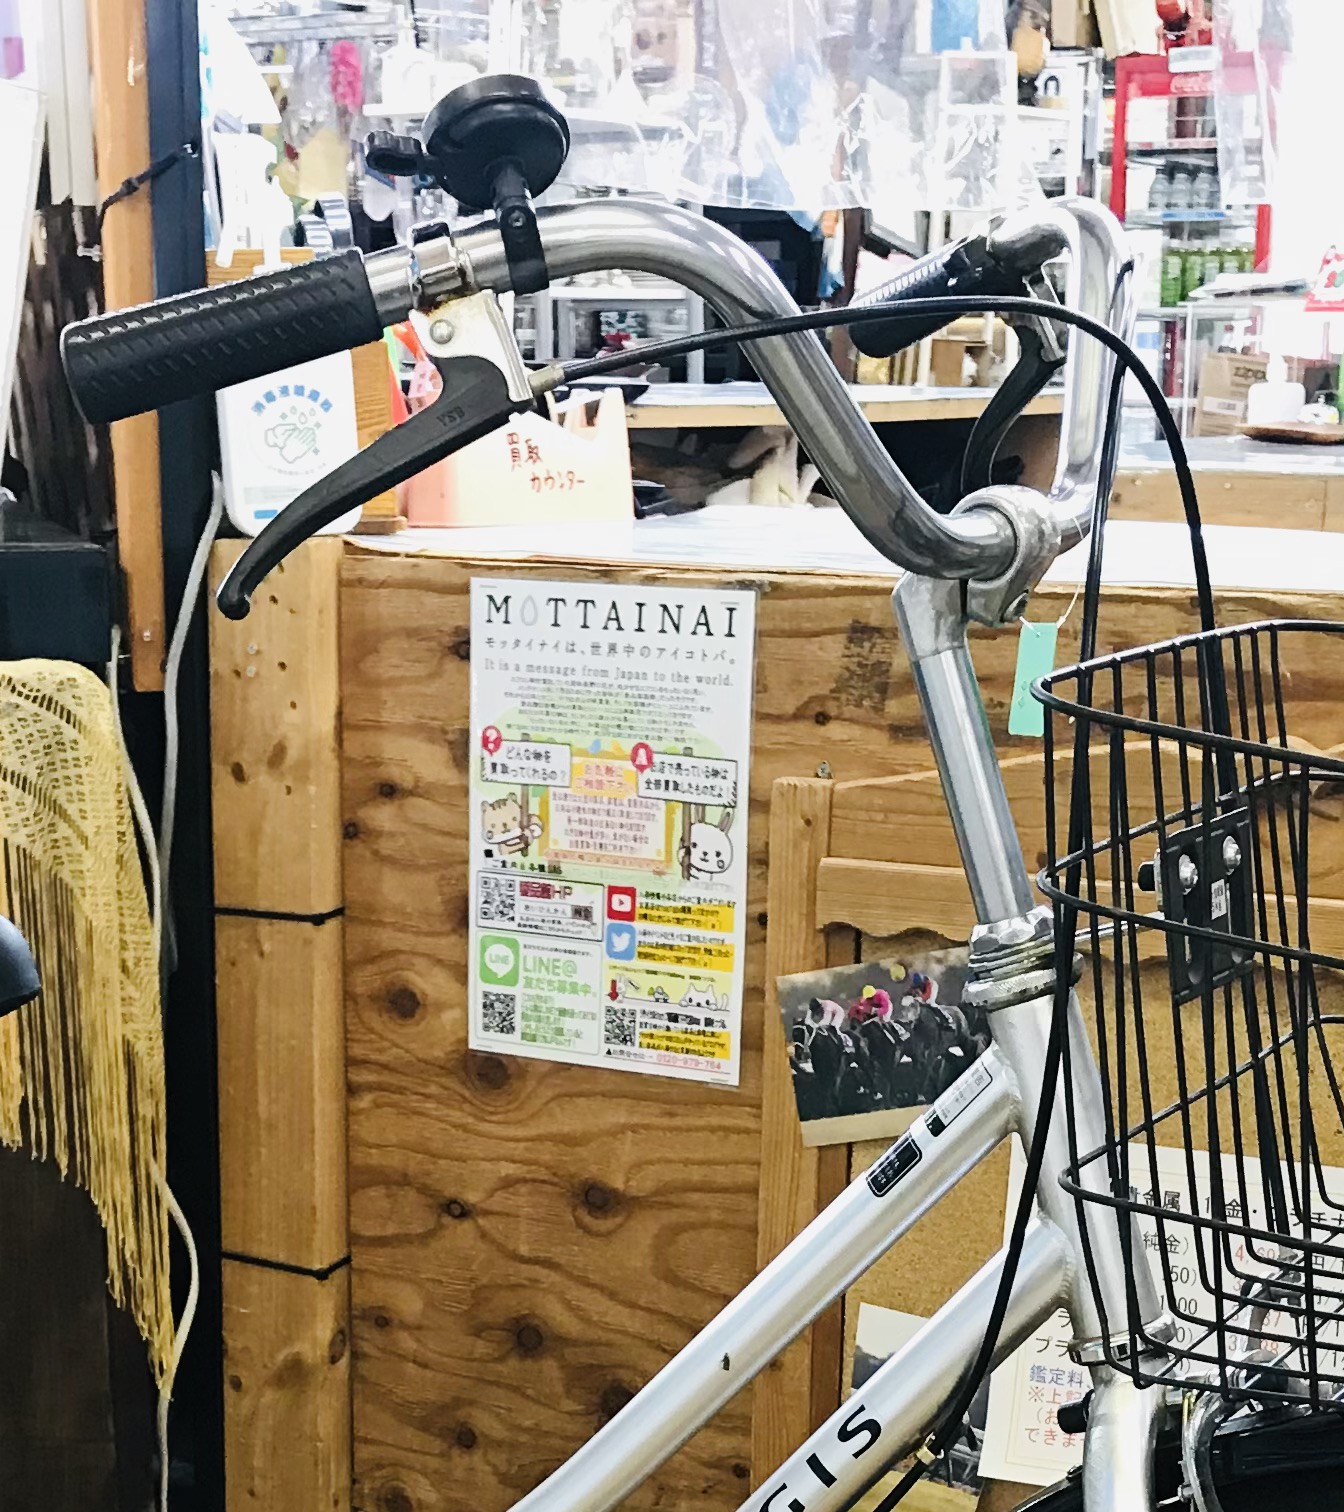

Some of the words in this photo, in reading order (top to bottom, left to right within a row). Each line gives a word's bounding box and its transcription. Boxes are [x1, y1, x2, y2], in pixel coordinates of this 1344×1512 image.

[507, 431, 543, 473] 買取
[530, 470, 585, 493] カウンター
[582, 664, 609, 678] from
[614, 666, 648, 681] Japan
[671, 671, 689, 683] the
[522, 955, 578, 978] LINE@
